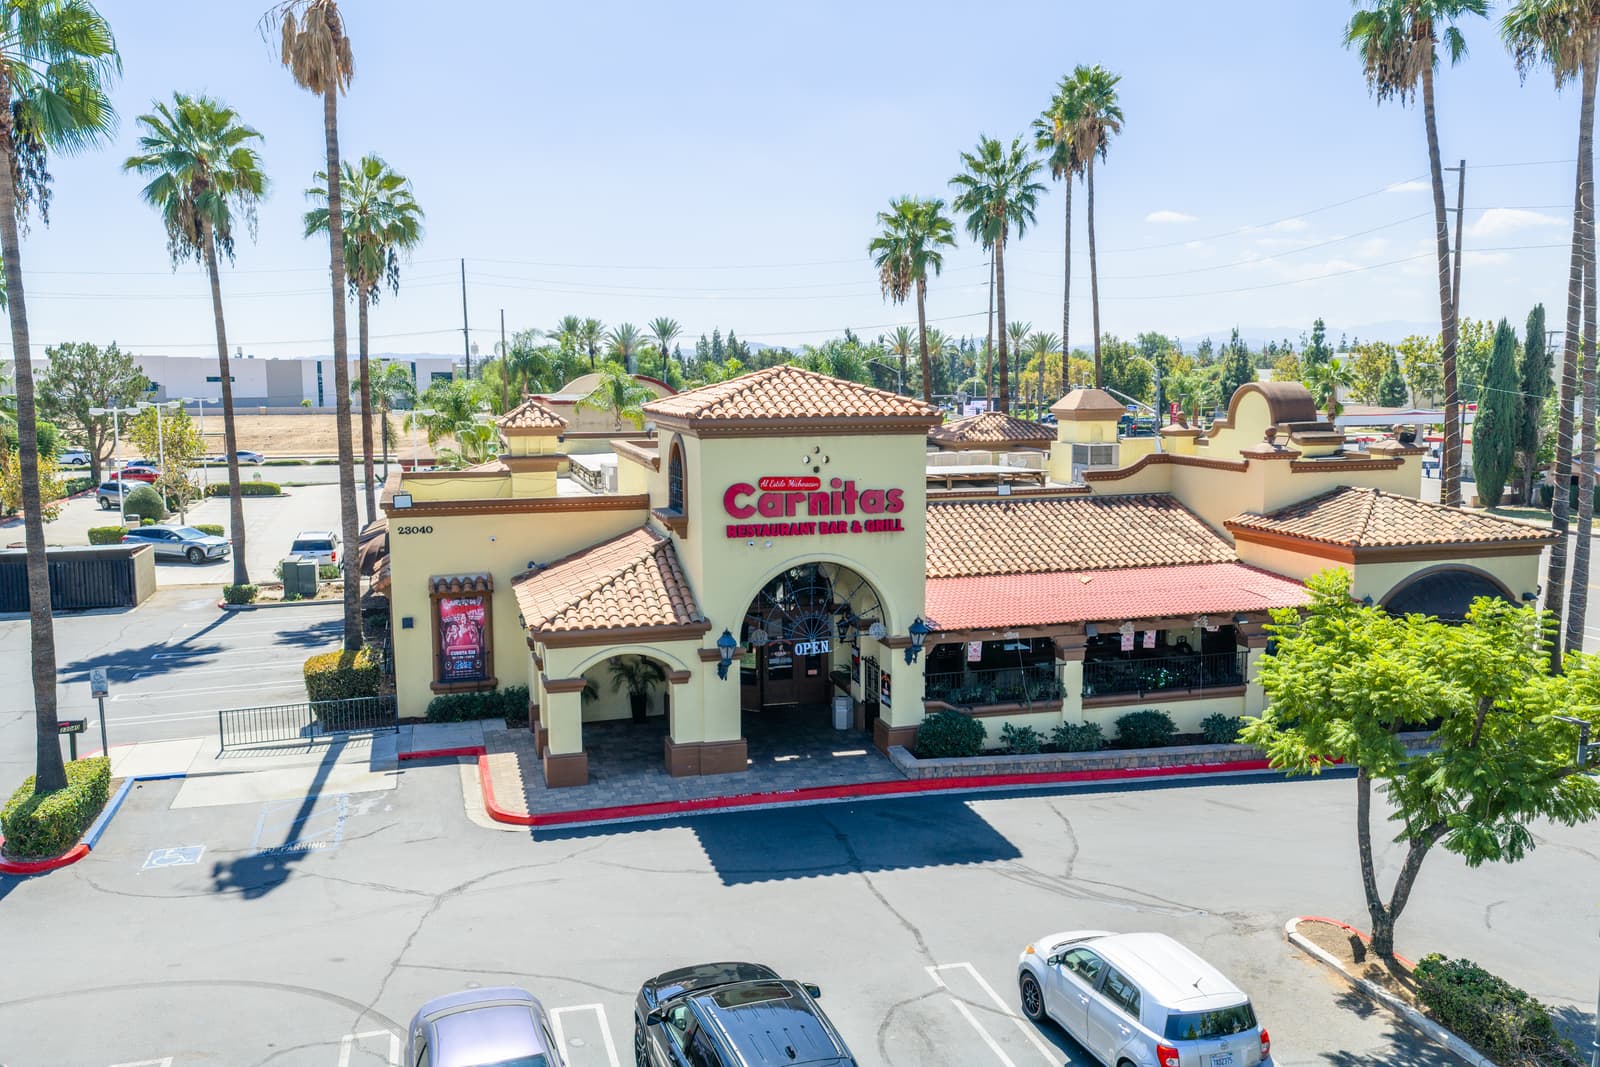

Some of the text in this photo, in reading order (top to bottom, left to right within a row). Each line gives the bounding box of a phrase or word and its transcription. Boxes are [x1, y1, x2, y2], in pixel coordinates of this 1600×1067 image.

[769, 479, 786, 488] Estilo
[723, 477, 904, 519] Carnitas
[397, 525, 433, 535] 23040
[726, 519, 905, 538] RESTAURANT BAR & GRILL
[794, 640, 829, 656] OPEN
[281, 841, 327, 852] PARKING
